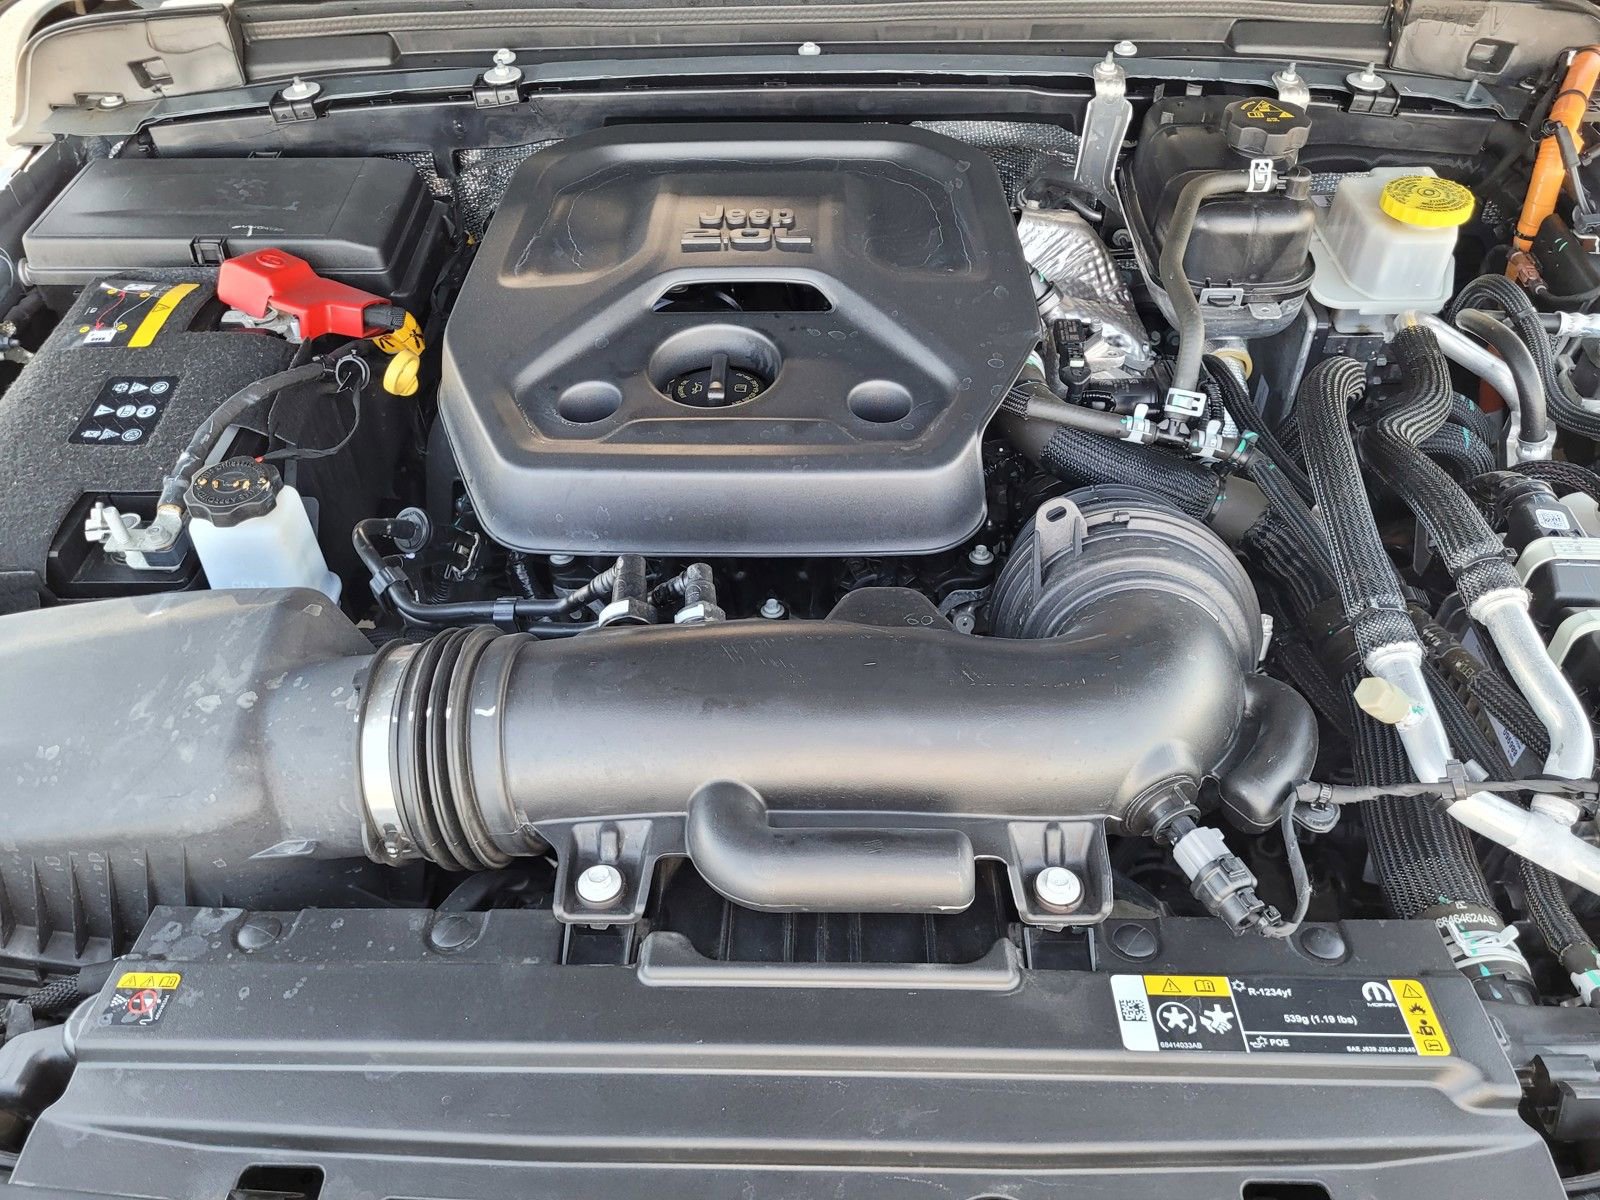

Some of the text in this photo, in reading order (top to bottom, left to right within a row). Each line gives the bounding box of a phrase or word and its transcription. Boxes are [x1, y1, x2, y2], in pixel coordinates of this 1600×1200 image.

[699, 204, 796, 230] Jeep
[680, 227, 814, 252] 2.0L
[904, 613, 934, 626] 60
[1247, 987, 1292, 999] R-1234yf
[1283, 1013, 1358, 1026] 539g (1.19 lbs)
[1269, 1038, 1290, 1048] POE
